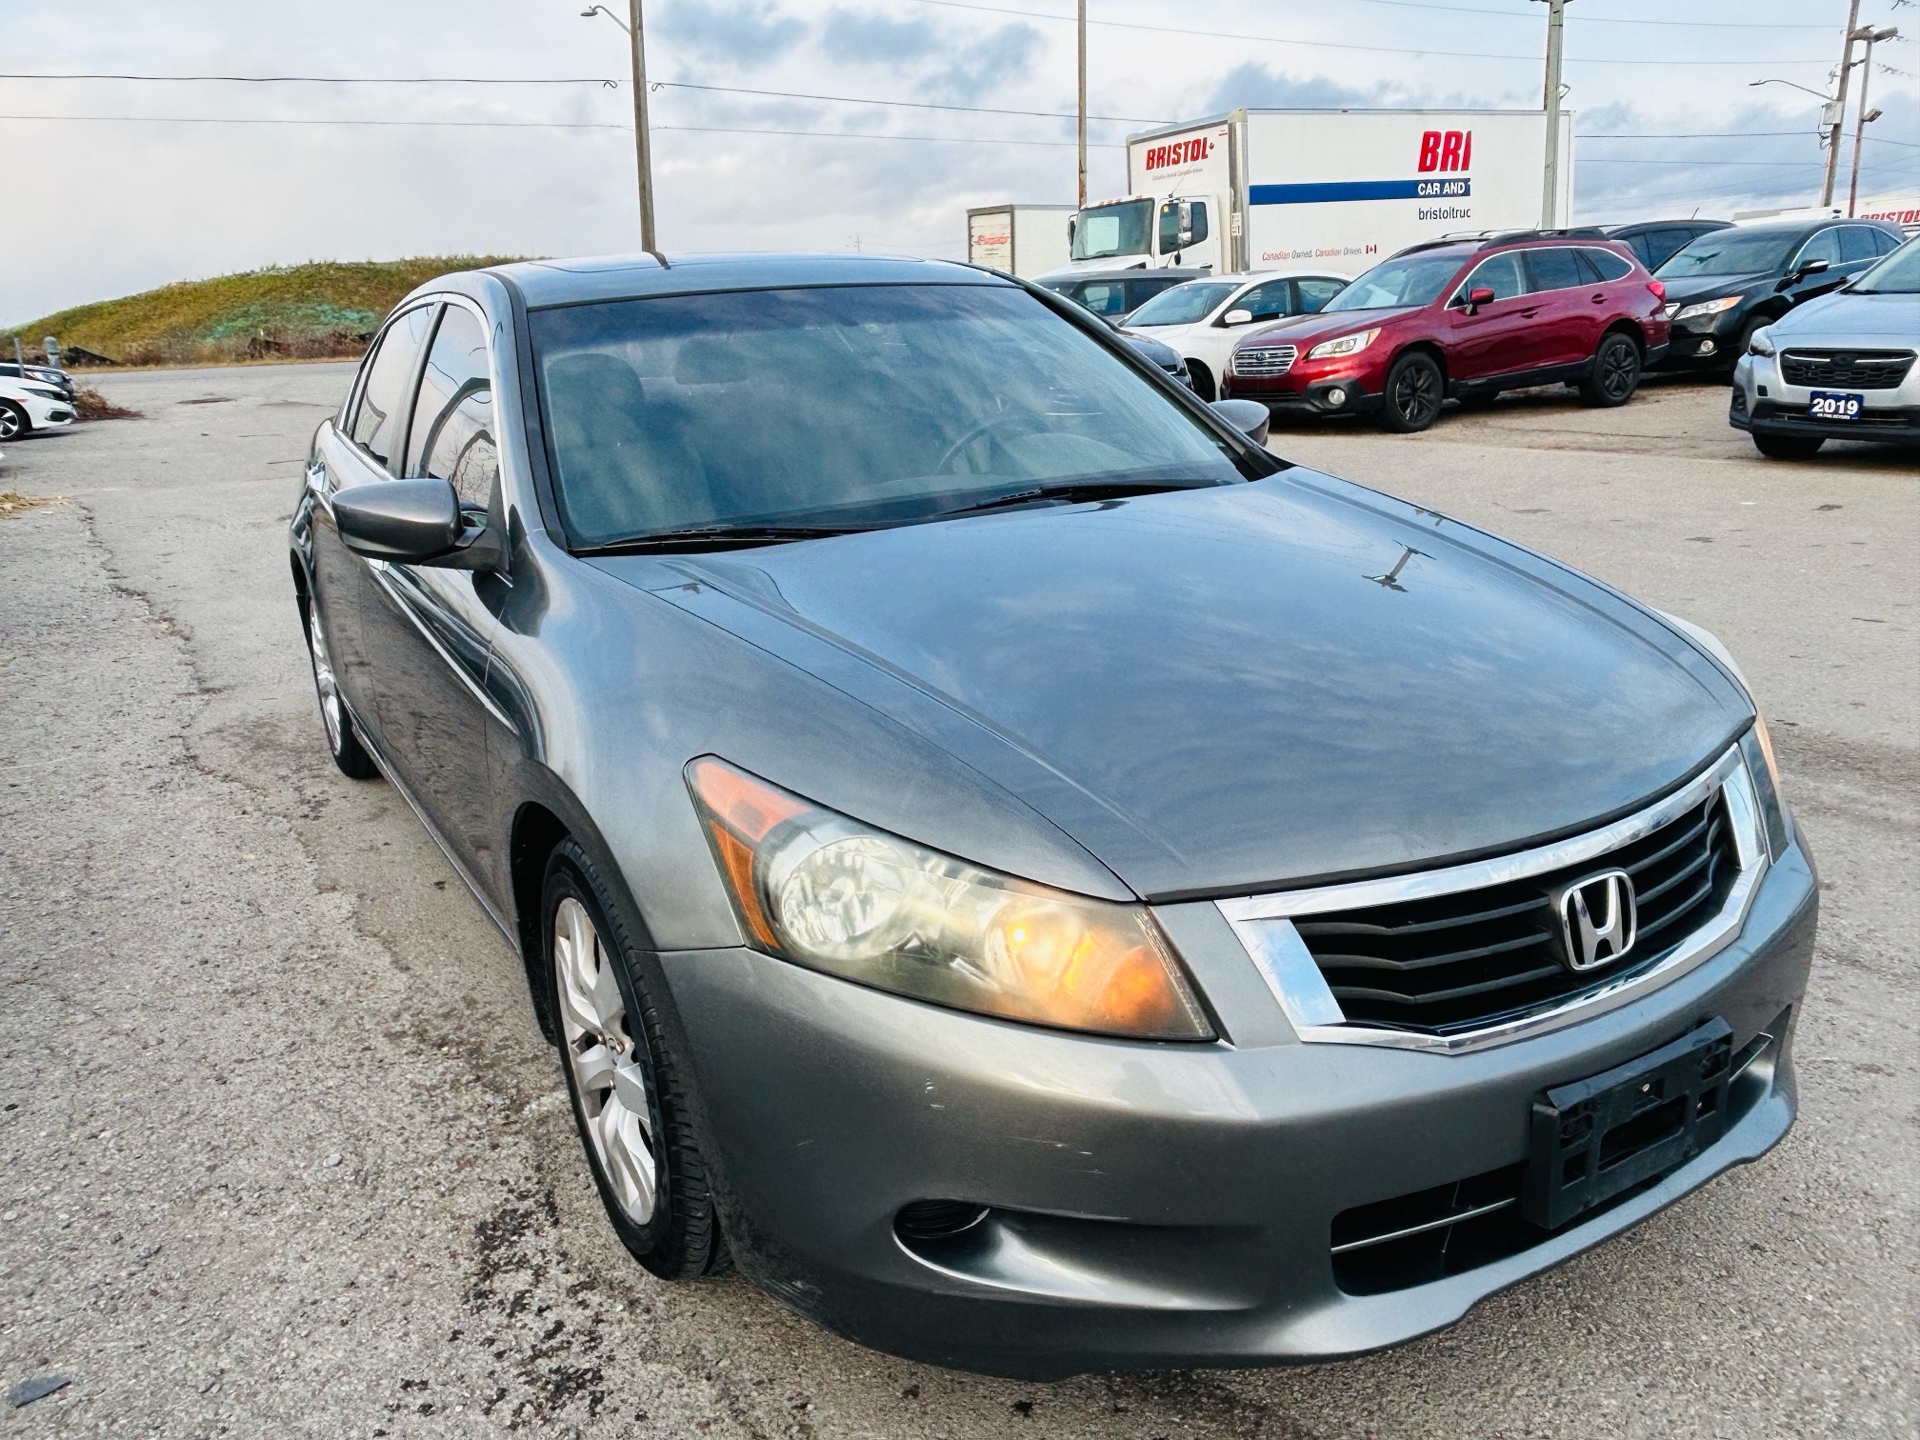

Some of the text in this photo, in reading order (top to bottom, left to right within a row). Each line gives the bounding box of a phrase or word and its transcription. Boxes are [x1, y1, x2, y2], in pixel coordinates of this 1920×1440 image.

[1146, 137, 1209, 171] BRISTOL
[1418, 181, 1465, 195] CAR AND
[1418, 205, 1471, 220] bristoltruc
[1811, 397, 1859, 415] 2019
